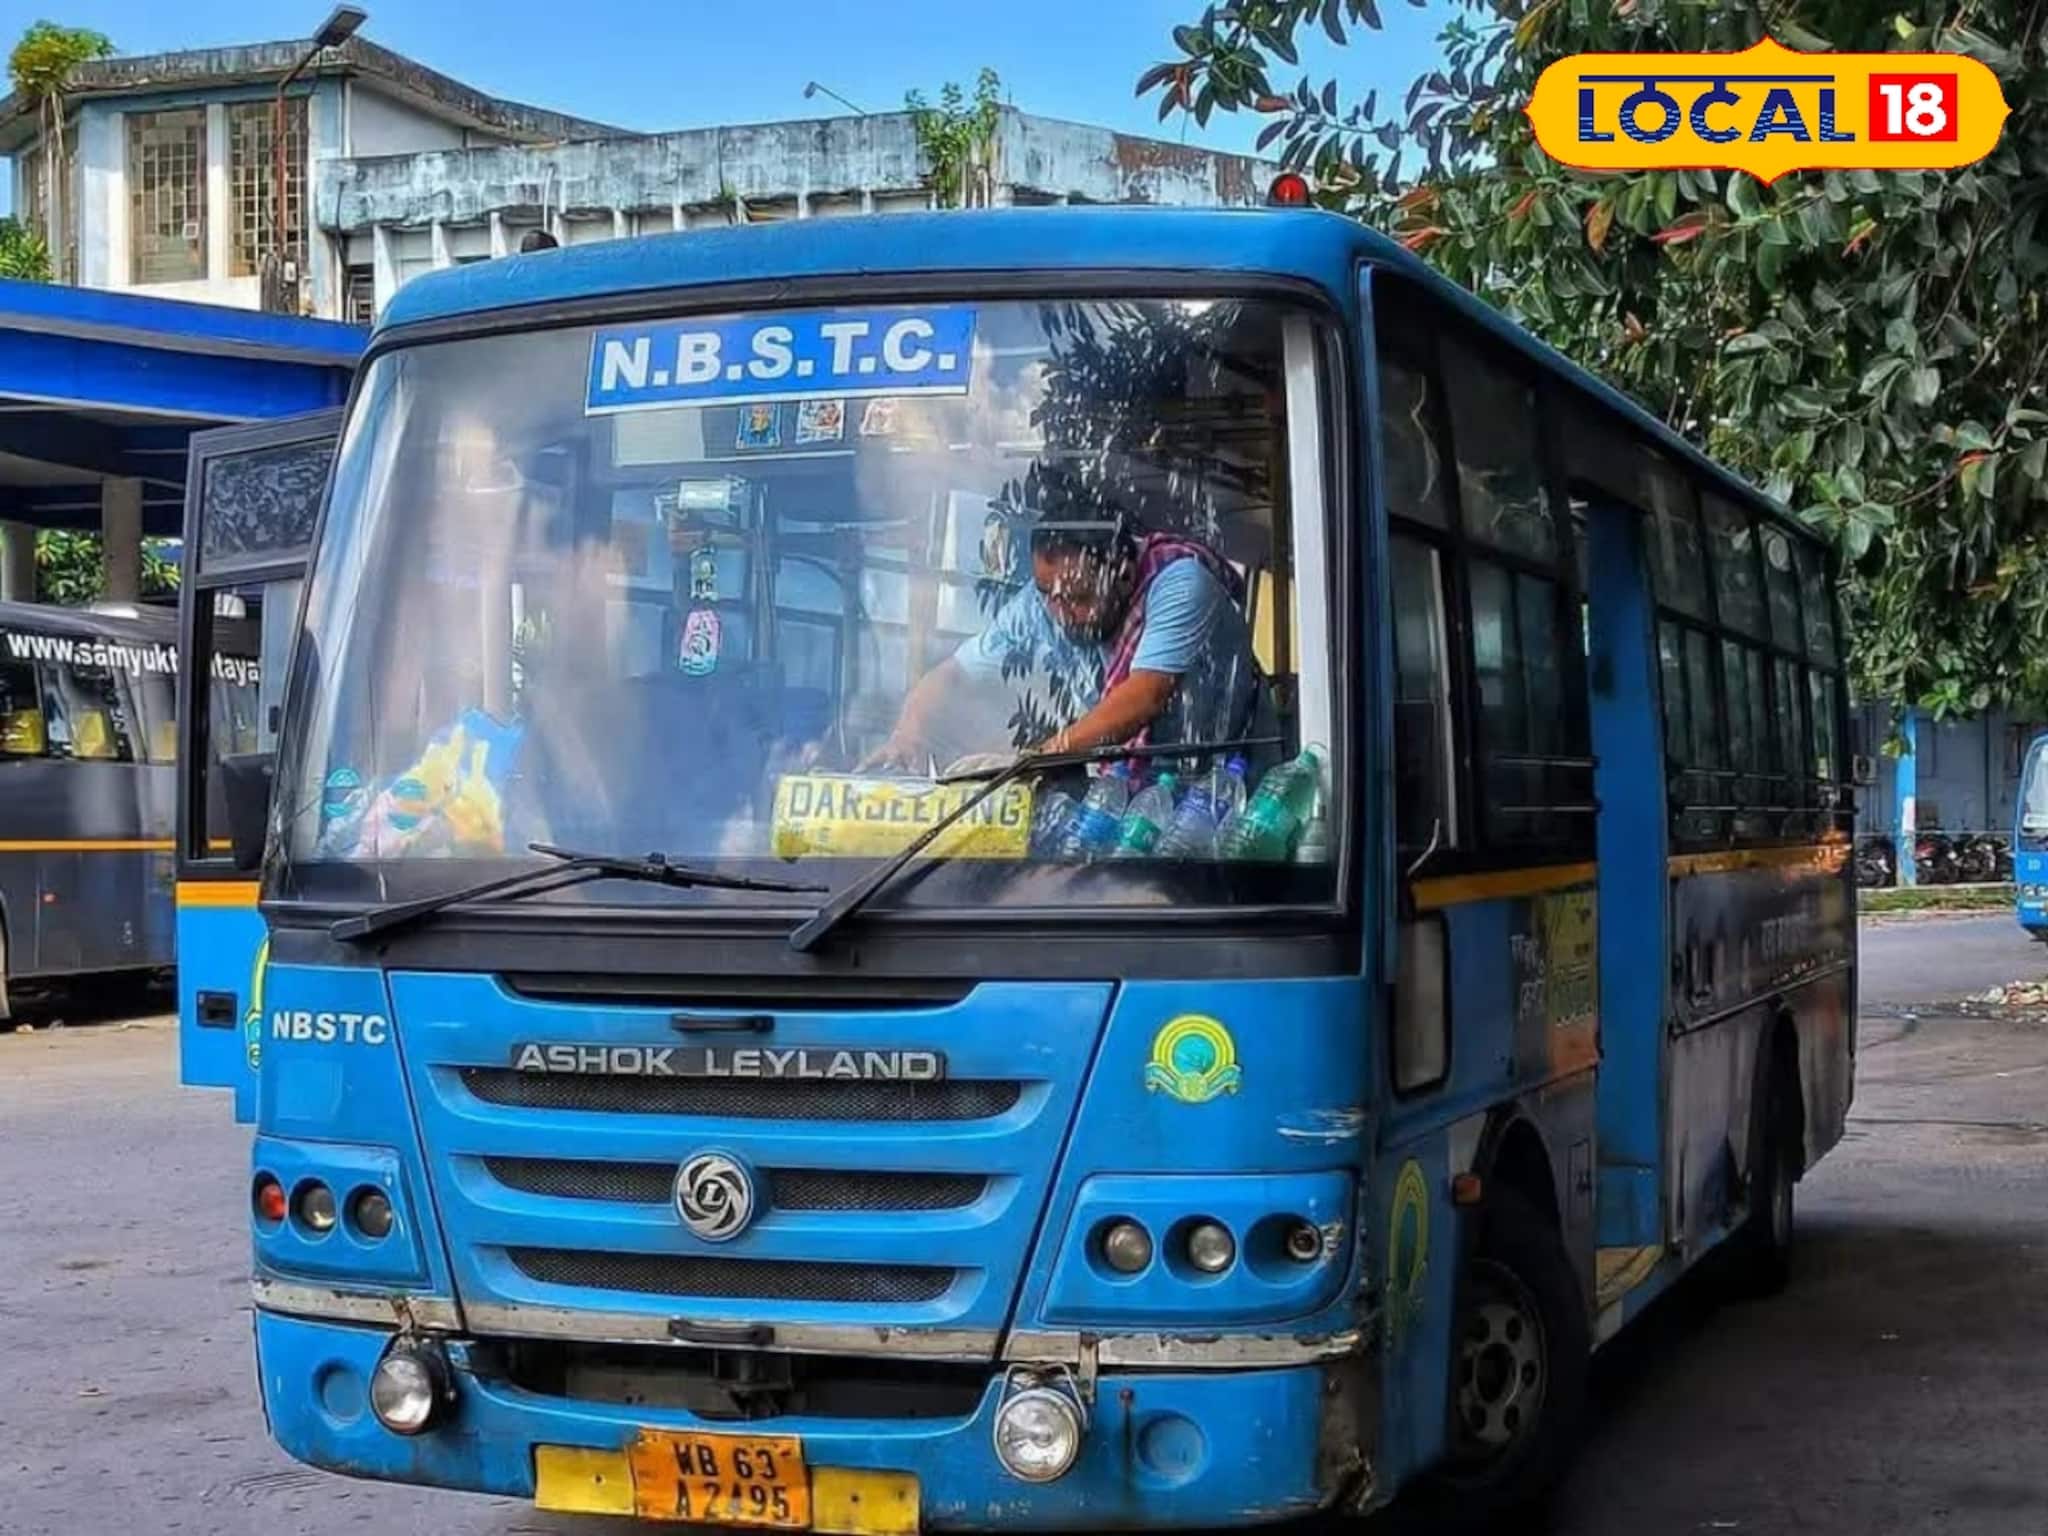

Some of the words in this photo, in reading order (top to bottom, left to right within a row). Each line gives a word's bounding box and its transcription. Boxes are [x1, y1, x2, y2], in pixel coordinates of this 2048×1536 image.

[600, 318, 956, 391] N.B.S.T.C.
[272, 1011, 386, 1044] NBSTC
[516, 1044, 674, 1074] ASHOK
[705, 1049, 938, 1080] LEYLAND
[673, 1441, 719, 1476] WB
[733, 1447, 777, 1479] 63
